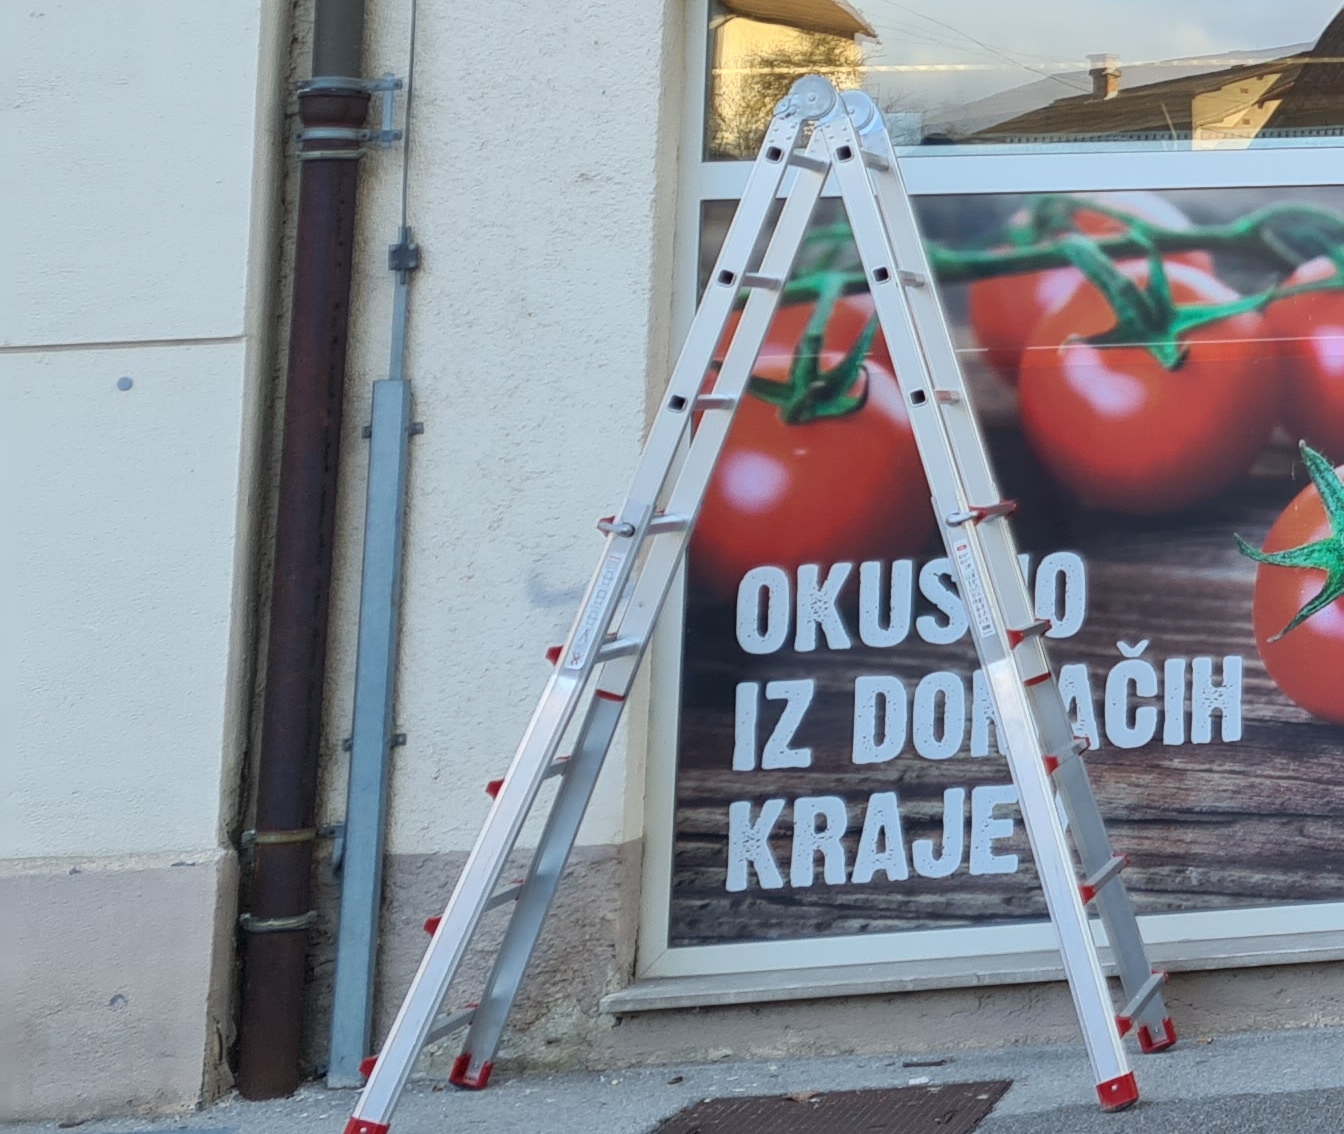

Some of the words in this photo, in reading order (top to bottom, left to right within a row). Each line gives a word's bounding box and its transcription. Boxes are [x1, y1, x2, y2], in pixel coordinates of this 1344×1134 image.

[736, 551, 1087, 655] OKUSO
[732, 679, 814, 771] IZ
[725, 784, 1070, 892] KRAJE
